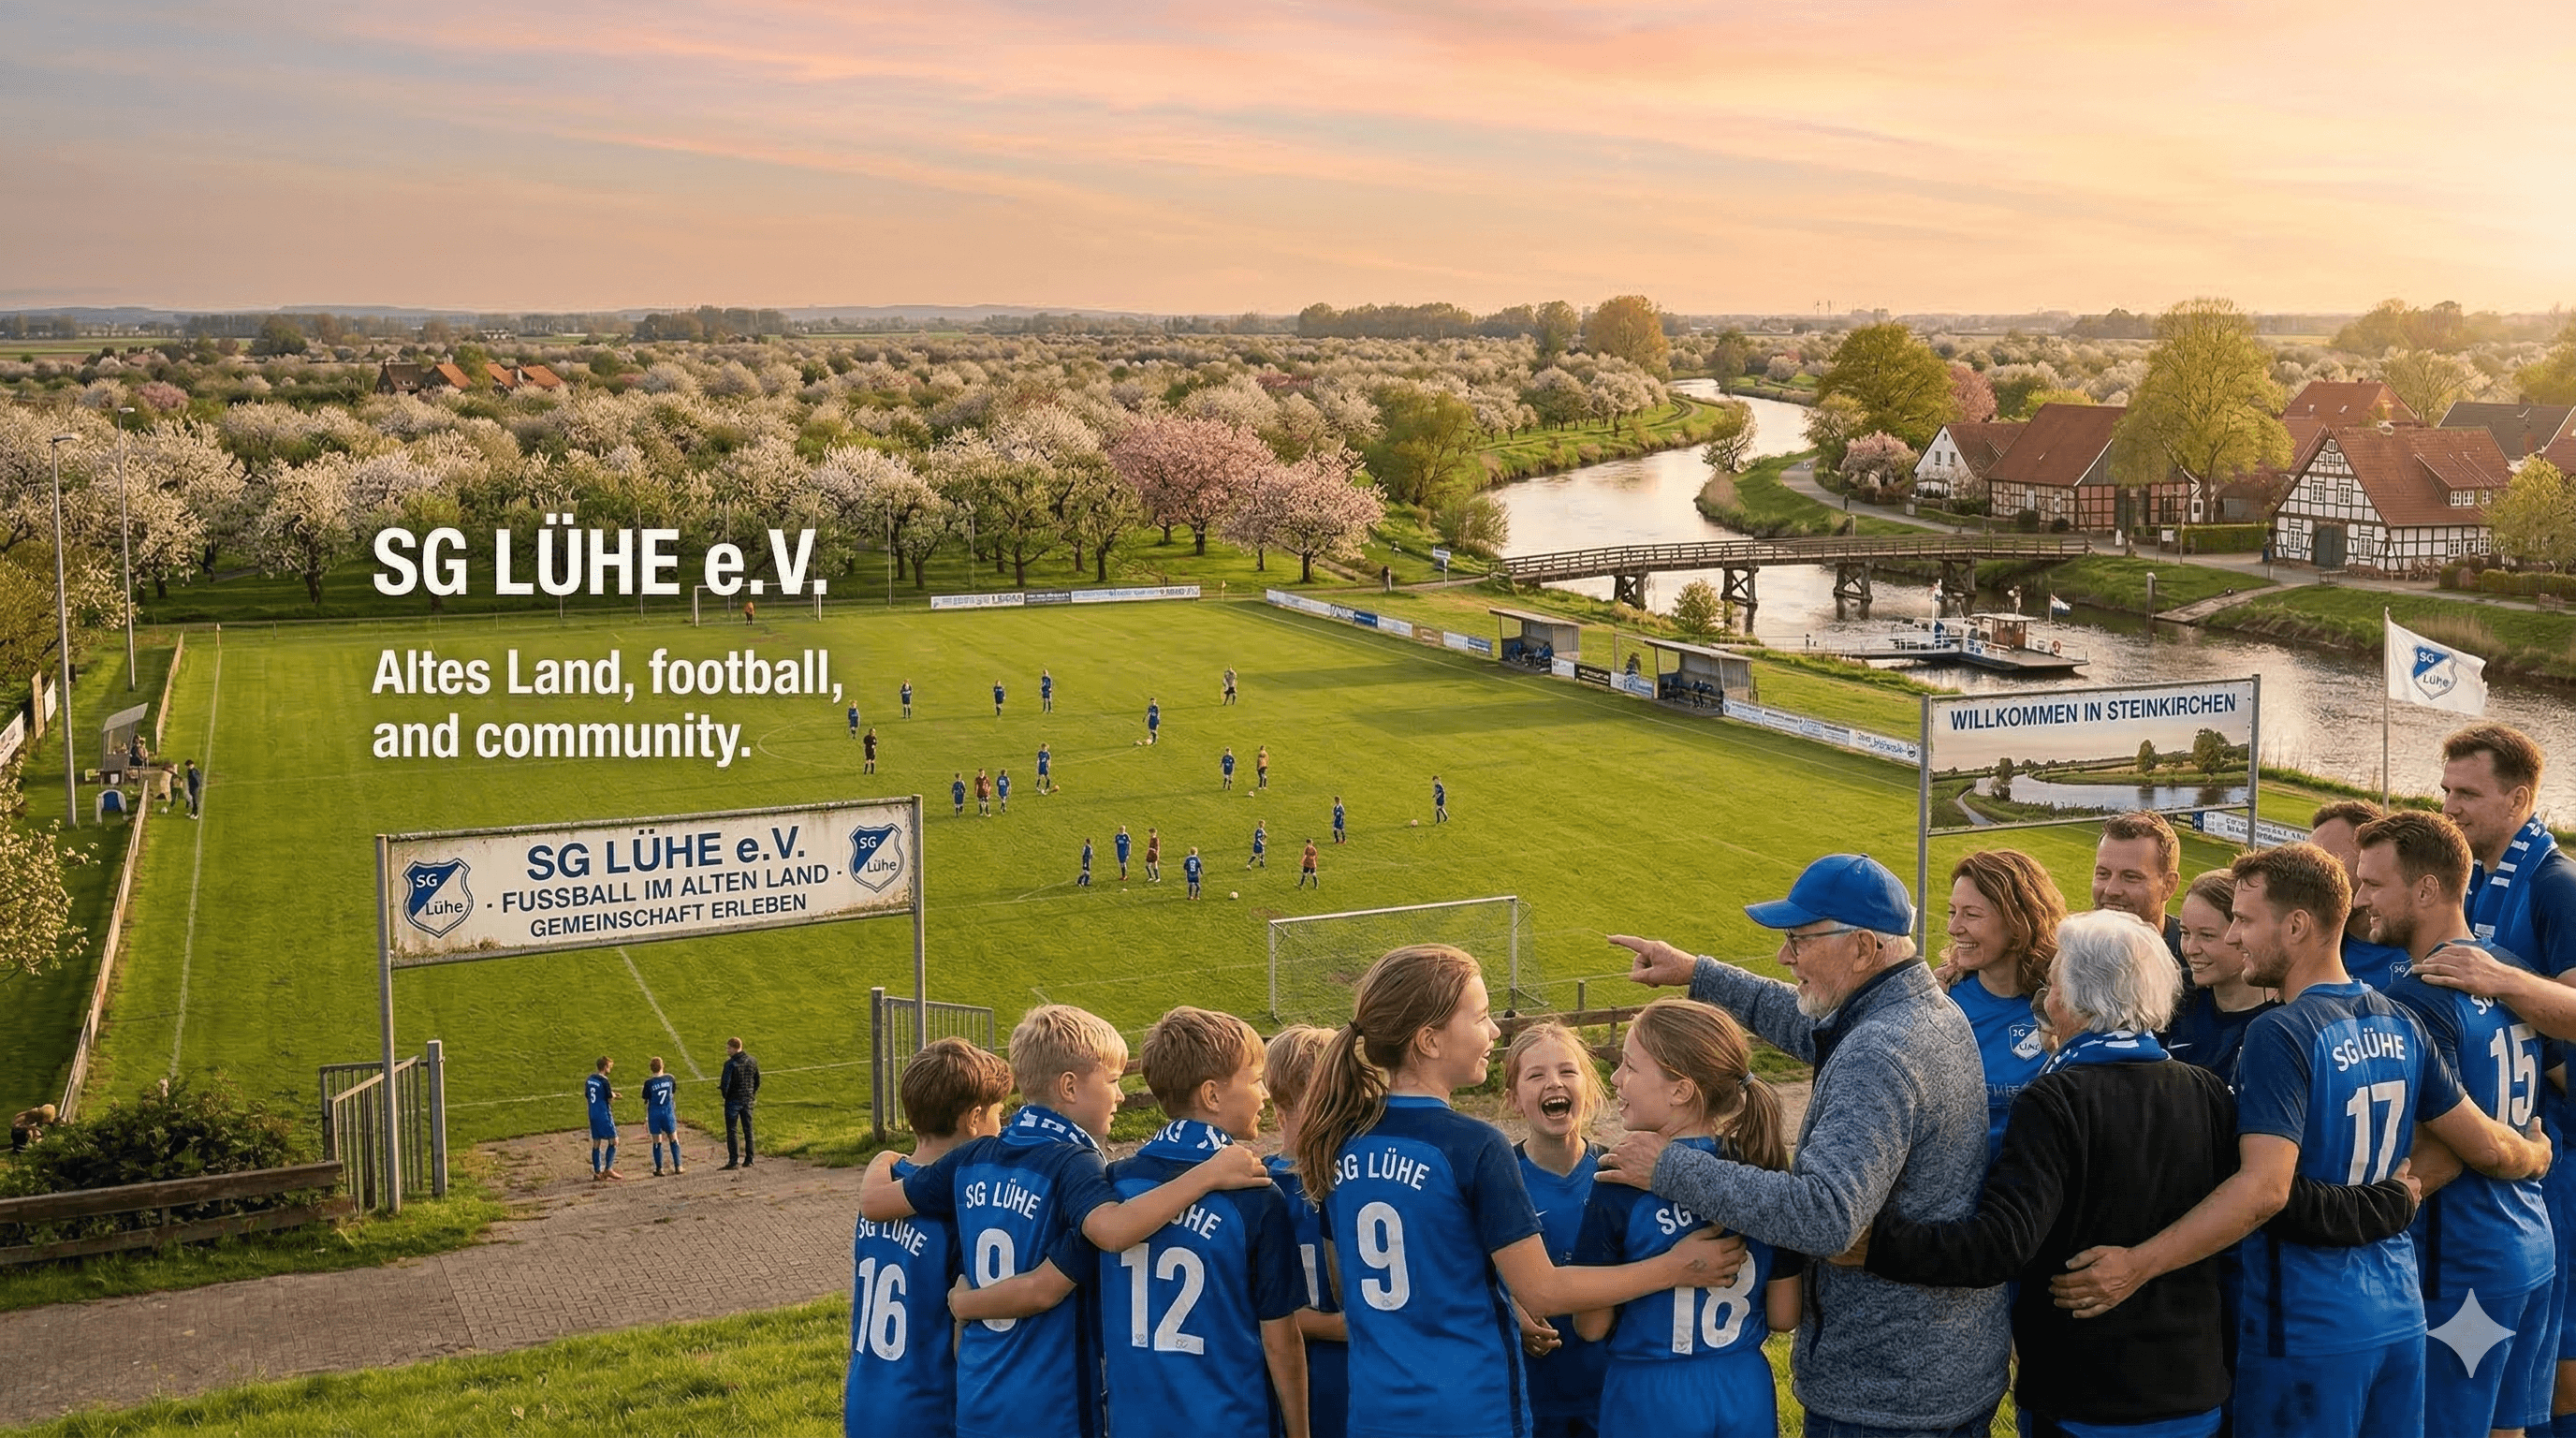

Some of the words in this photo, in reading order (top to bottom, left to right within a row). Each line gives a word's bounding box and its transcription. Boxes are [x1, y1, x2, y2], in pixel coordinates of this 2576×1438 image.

[2419, 652, 2435, 664] SG
[1951, 703, 2078, 730] WILLKOMMEN
[2084, 701, 2101, 722] IN
[2107, 693, 2236, 721] STEINKIRCHEN
[526, 842, 591, 881] SG
[606, 828, 724, 874] LÜHE
[736, 825, 805, 863] e.V.
[859, 836, 877, 849] SG
[416, 873, 437, 888] SG
[867, 858, 897, 873] Lühe
[426, 900, 463, 916] Lühe
[502, 881, 637, 914] FUSSBALL
[645, 878, 672, 901] IM
[681, 870, 757, 897] ALTEN
[766, 864, 829, 888] LAND
[530, 903, 705, 937] GEMEINSCHAFT
[711, 893, 807, 919] ERLEBEN
[2490, 1023, 2537, 1127] 15
[657, 1090, 667, 1105] 7
[2347, 1079, 2406, 1186] 17
[1368, 1147, 1430, 1191] LÜHE
[965, 1181, 986, 1209] SG
[992, 1178, 1041, 1220] LÜHE
[1357, 1201, 1410, 1311] 9
[856, 1257, 907, 1361] 16
[1120, 1242, 1205, 1355] 12
